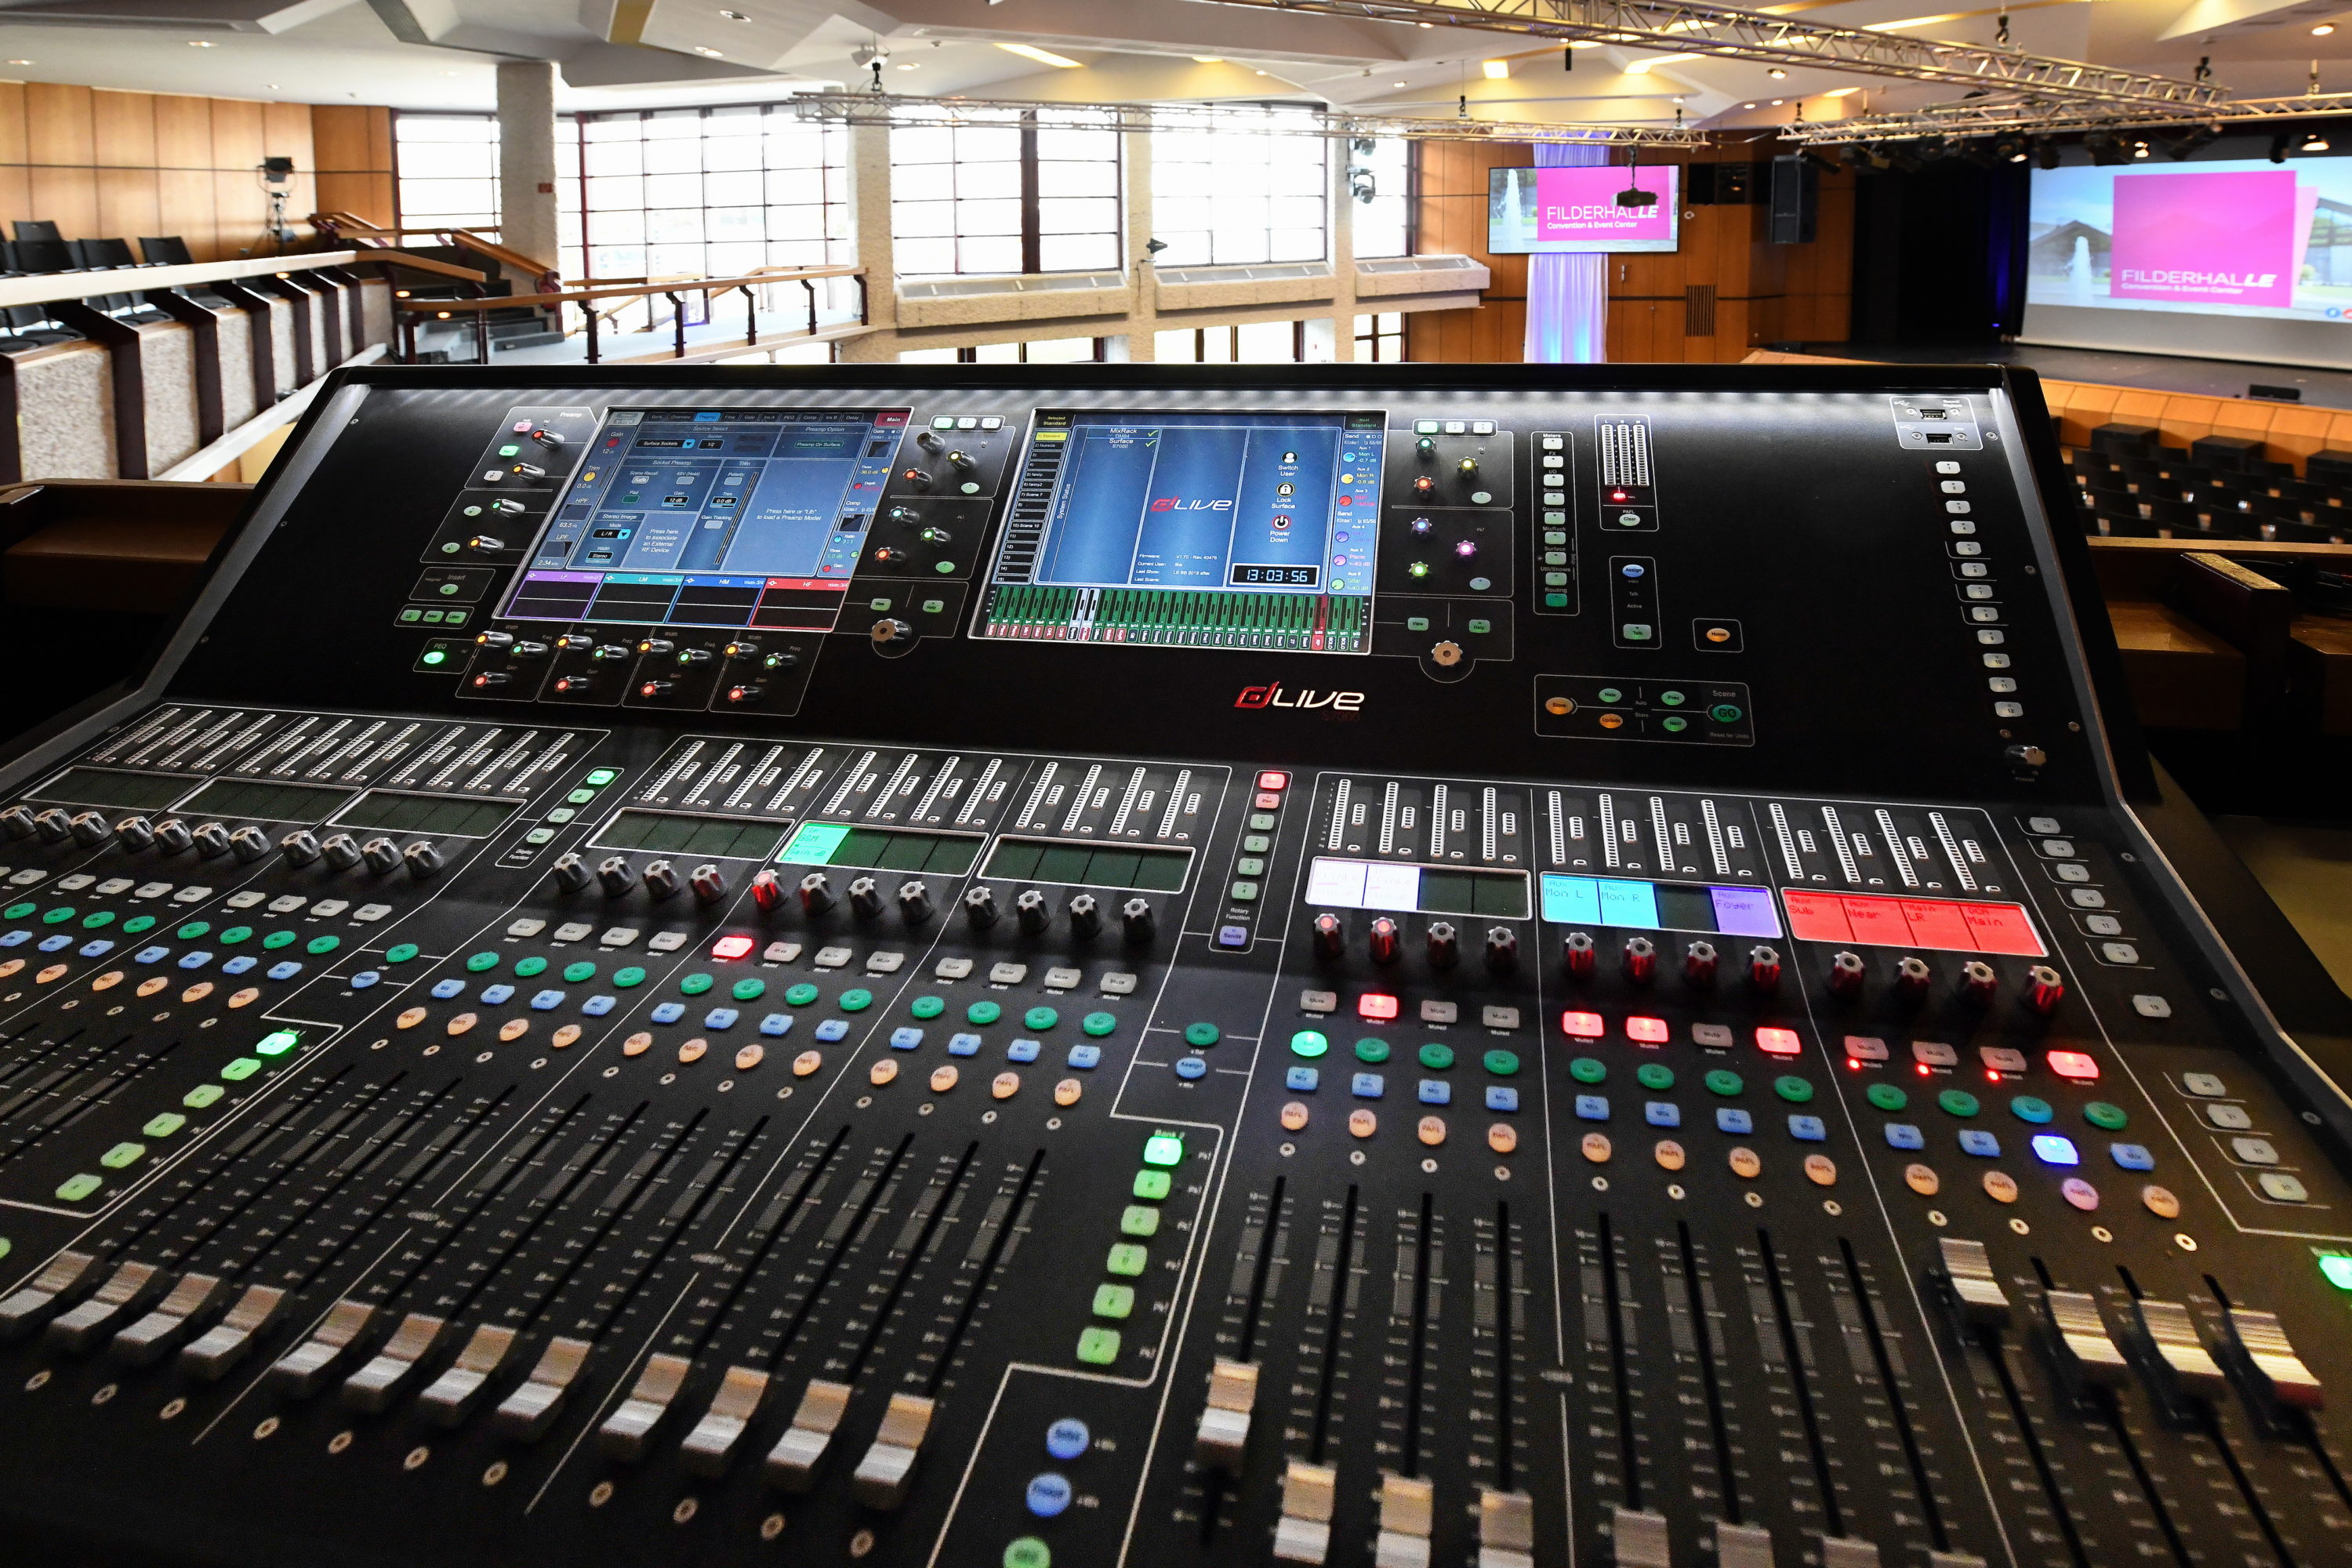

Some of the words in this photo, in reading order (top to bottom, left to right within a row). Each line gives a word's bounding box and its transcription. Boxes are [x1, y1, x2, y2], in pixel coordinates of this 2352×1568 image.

[1718, 708, 1737, 717] GO
[1545, 888, 1569, 898] Mon
[1601, 891, 1625, 902] Mon
[1967, 916, 2003, 927] Main
